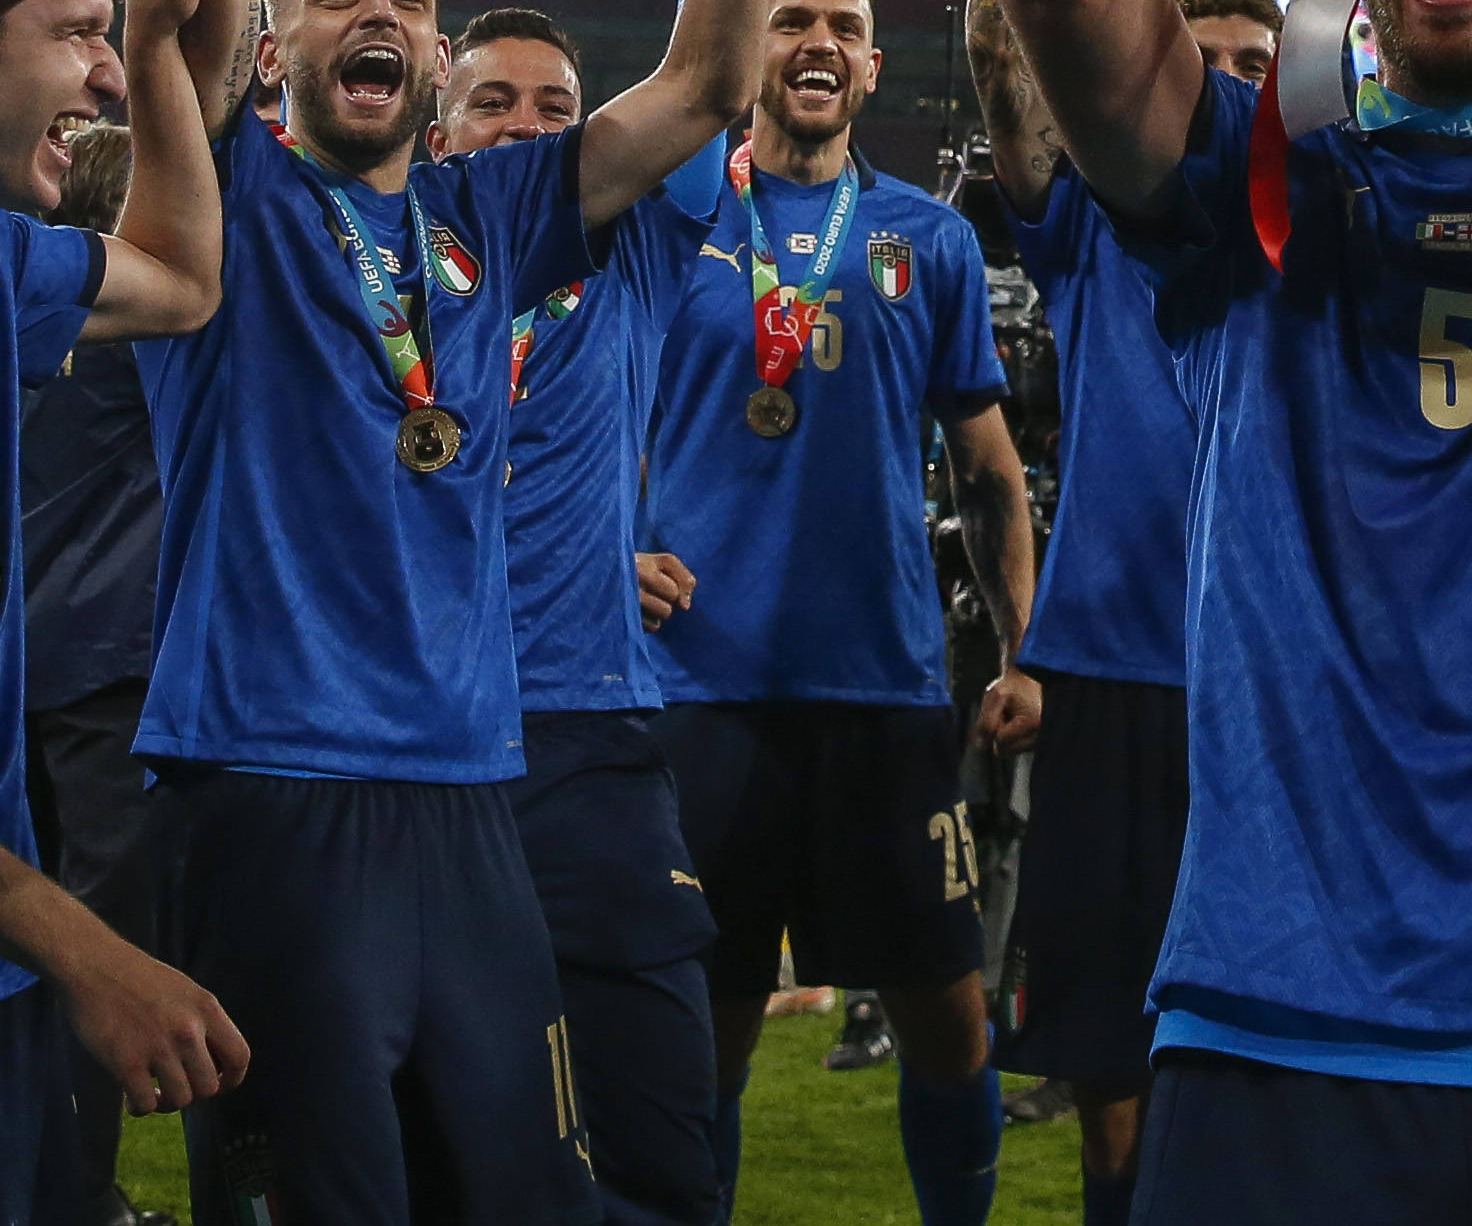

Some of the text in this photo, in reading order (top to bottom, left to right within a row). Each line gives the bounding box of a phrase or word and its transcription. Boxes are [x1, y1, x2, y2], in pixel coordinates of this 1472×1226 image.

[813, 185, 852, 276] UEFA EURO 2020
